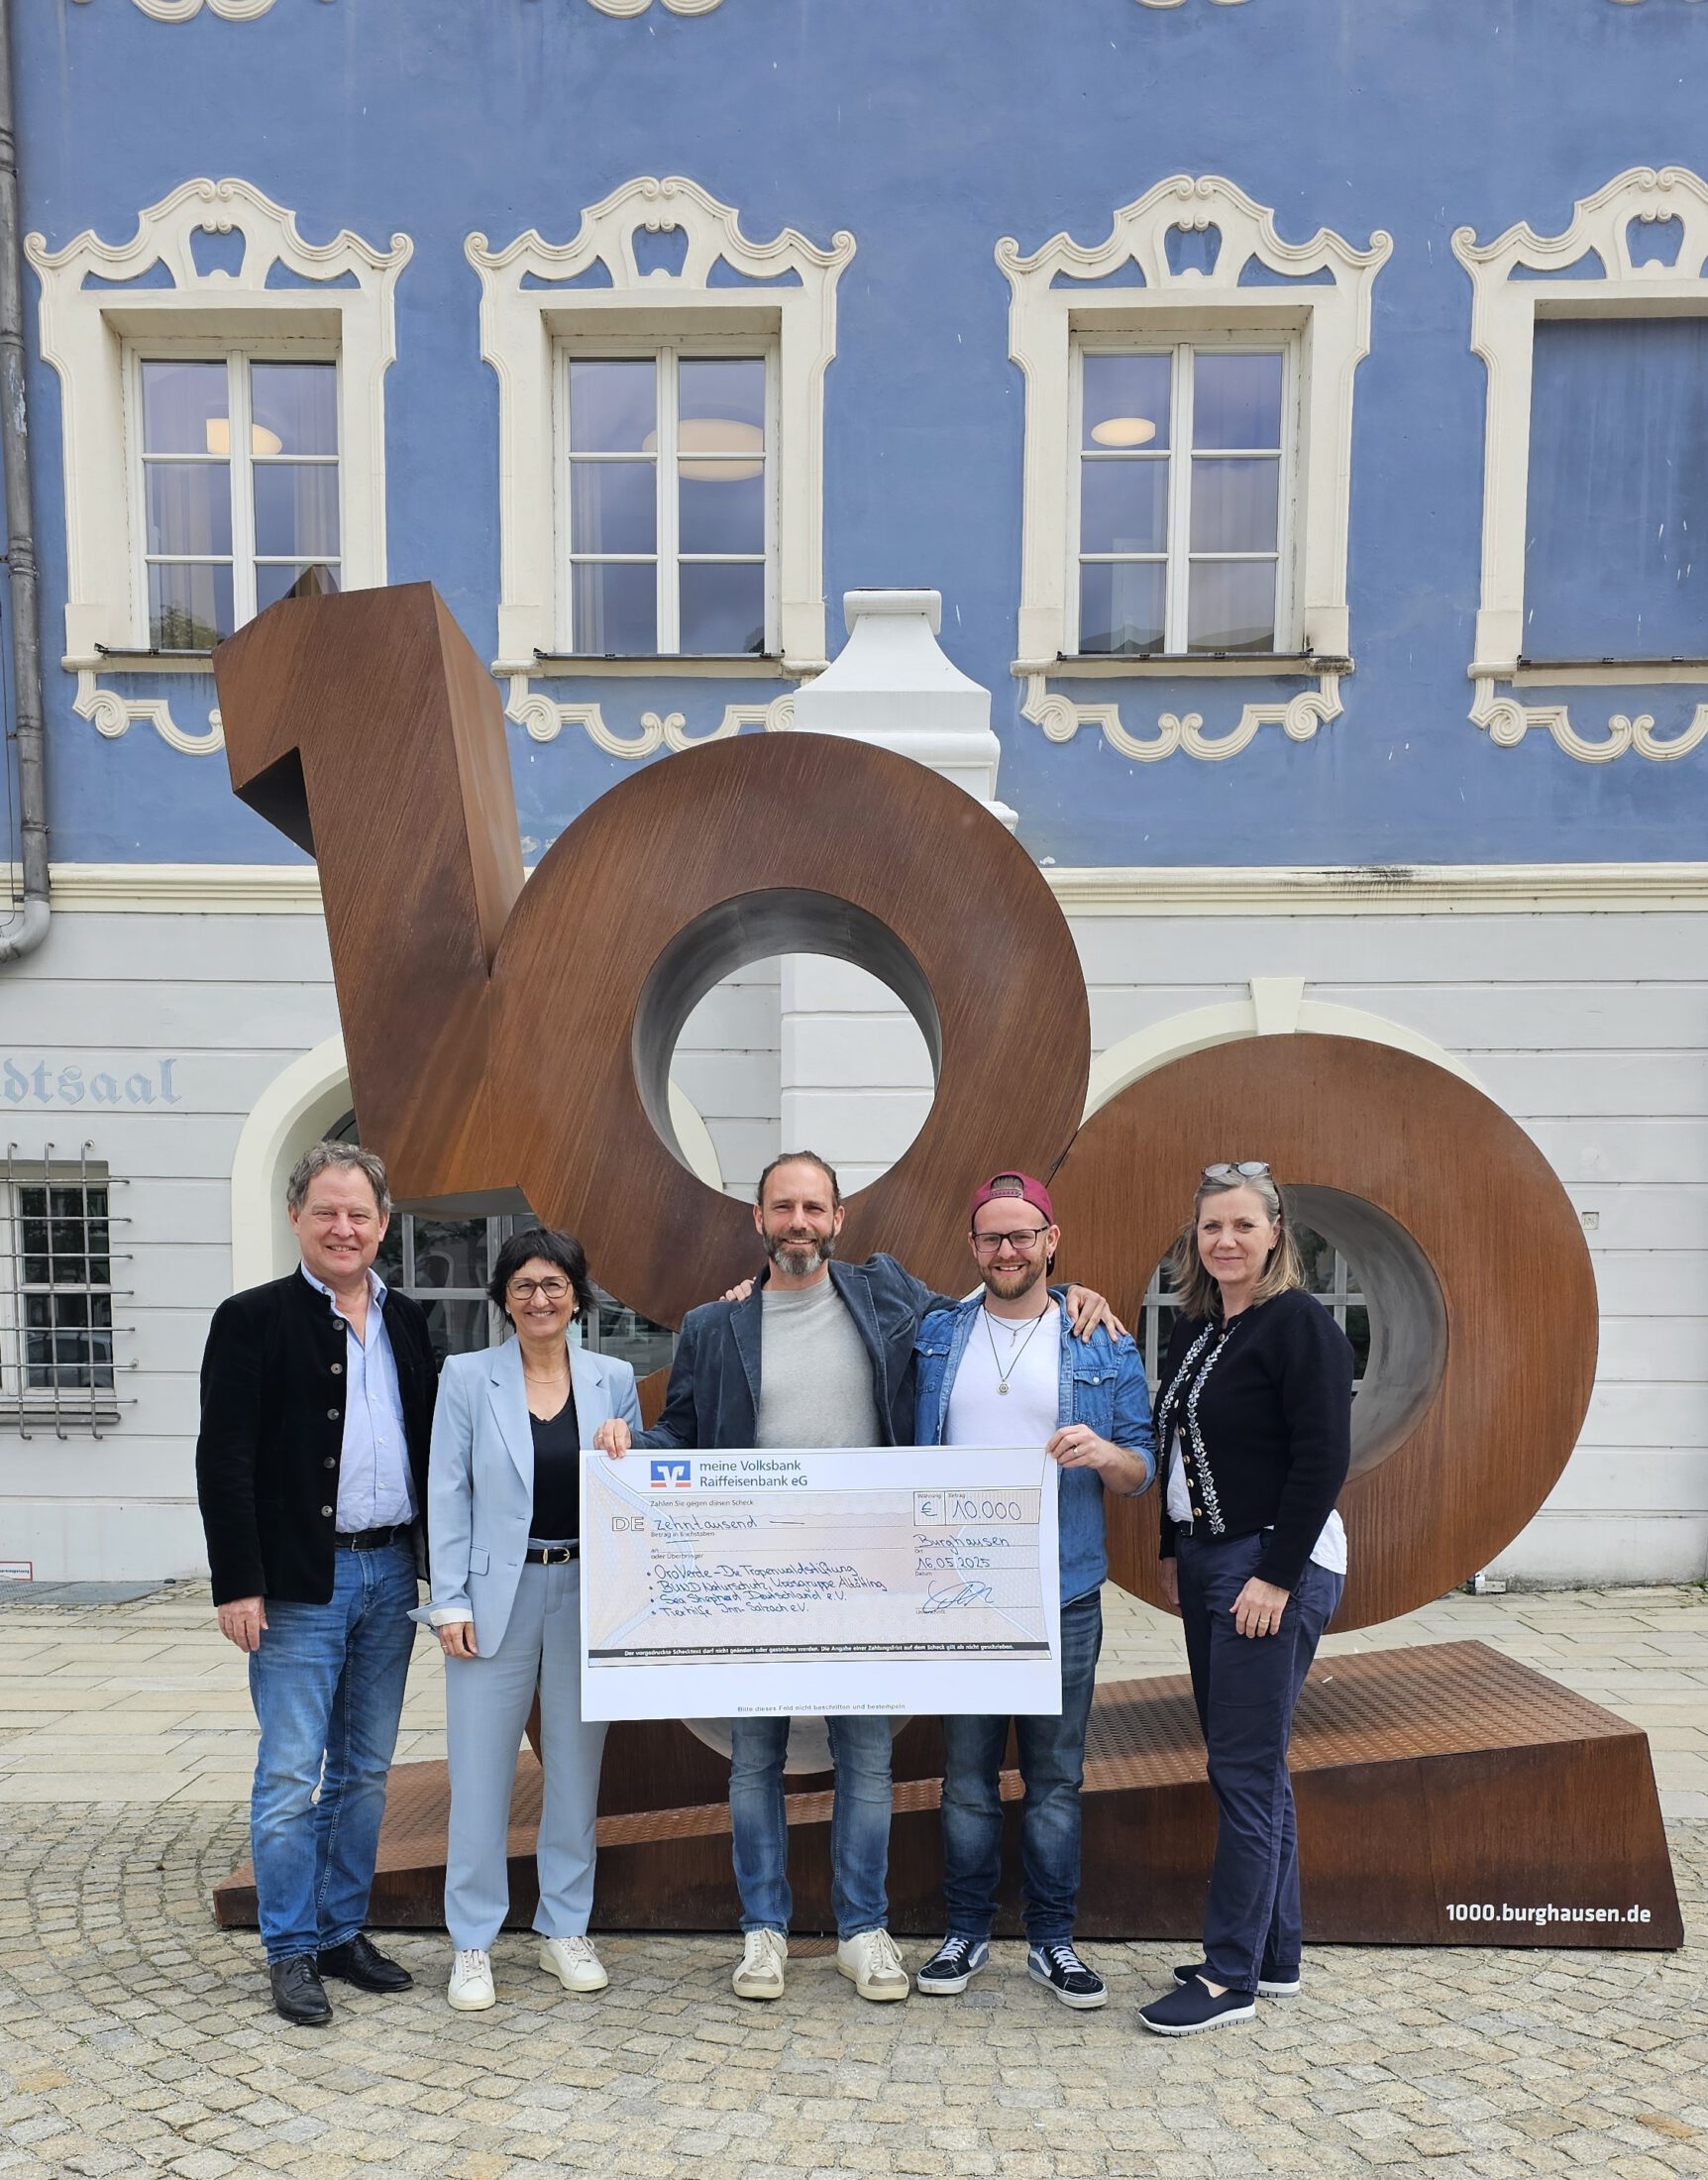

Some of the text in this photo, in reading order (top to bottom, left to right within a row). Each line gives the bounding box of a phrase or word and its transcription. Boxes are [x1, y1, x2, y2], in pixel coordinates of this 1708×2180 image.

[0, 1058, 182, 1105] dtsaal
[699, 1460, 801, 1472] meine Volksbank
[699, 1476, 808, 1487] Raiffeisenbank eG
[952, 1499, 1021, 1521] 10.000
[611, 1516, 644, 1532] DE
[912, 1533, 1011, 1556] Burghausen
[659, 1593, 687, 1604] Sea
[1445, 1903, 1652, 1926] 1000.burghausen.de
